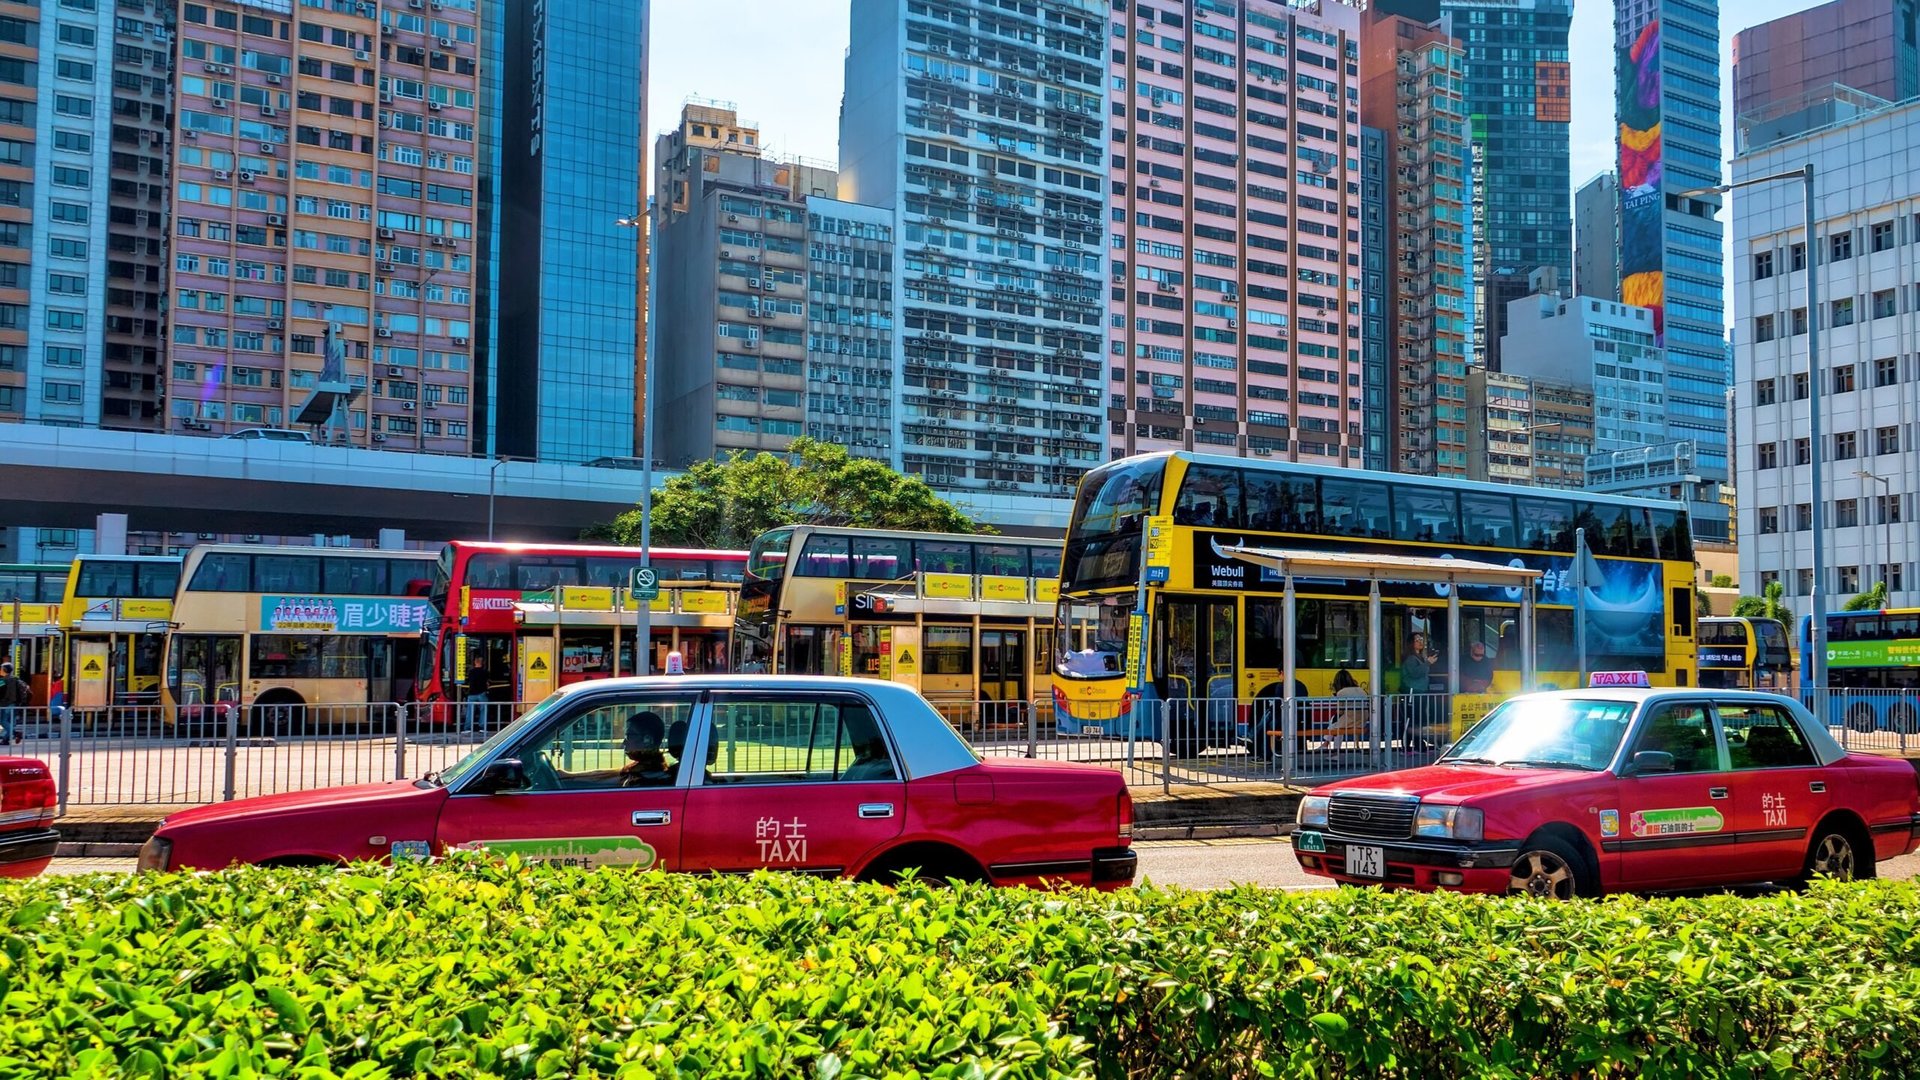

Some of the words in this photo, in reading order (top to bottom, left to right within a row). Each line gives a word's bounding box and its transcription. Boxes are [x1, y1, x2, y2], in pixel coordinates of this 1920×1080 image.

[1624, 199, 1638, 209] TAI
[1640, 192, 1660, 205] PING
[1211, 565, 1244, 577] Webull
[867, 658, 880, 671] 115
[1593, 672, 1638, 685] TAXI
[1762, 792, 1786, 808] 的士
[1763, 809, 1787, 826] TAXI
[756, 816, 807, 838] 的士
[1307, 835, 1314, 844] 4
[756, 839, 807, 862] TAXI
[1357, 846, 1373, 861] TR
[1353, 860, 1377, 875] 1143
